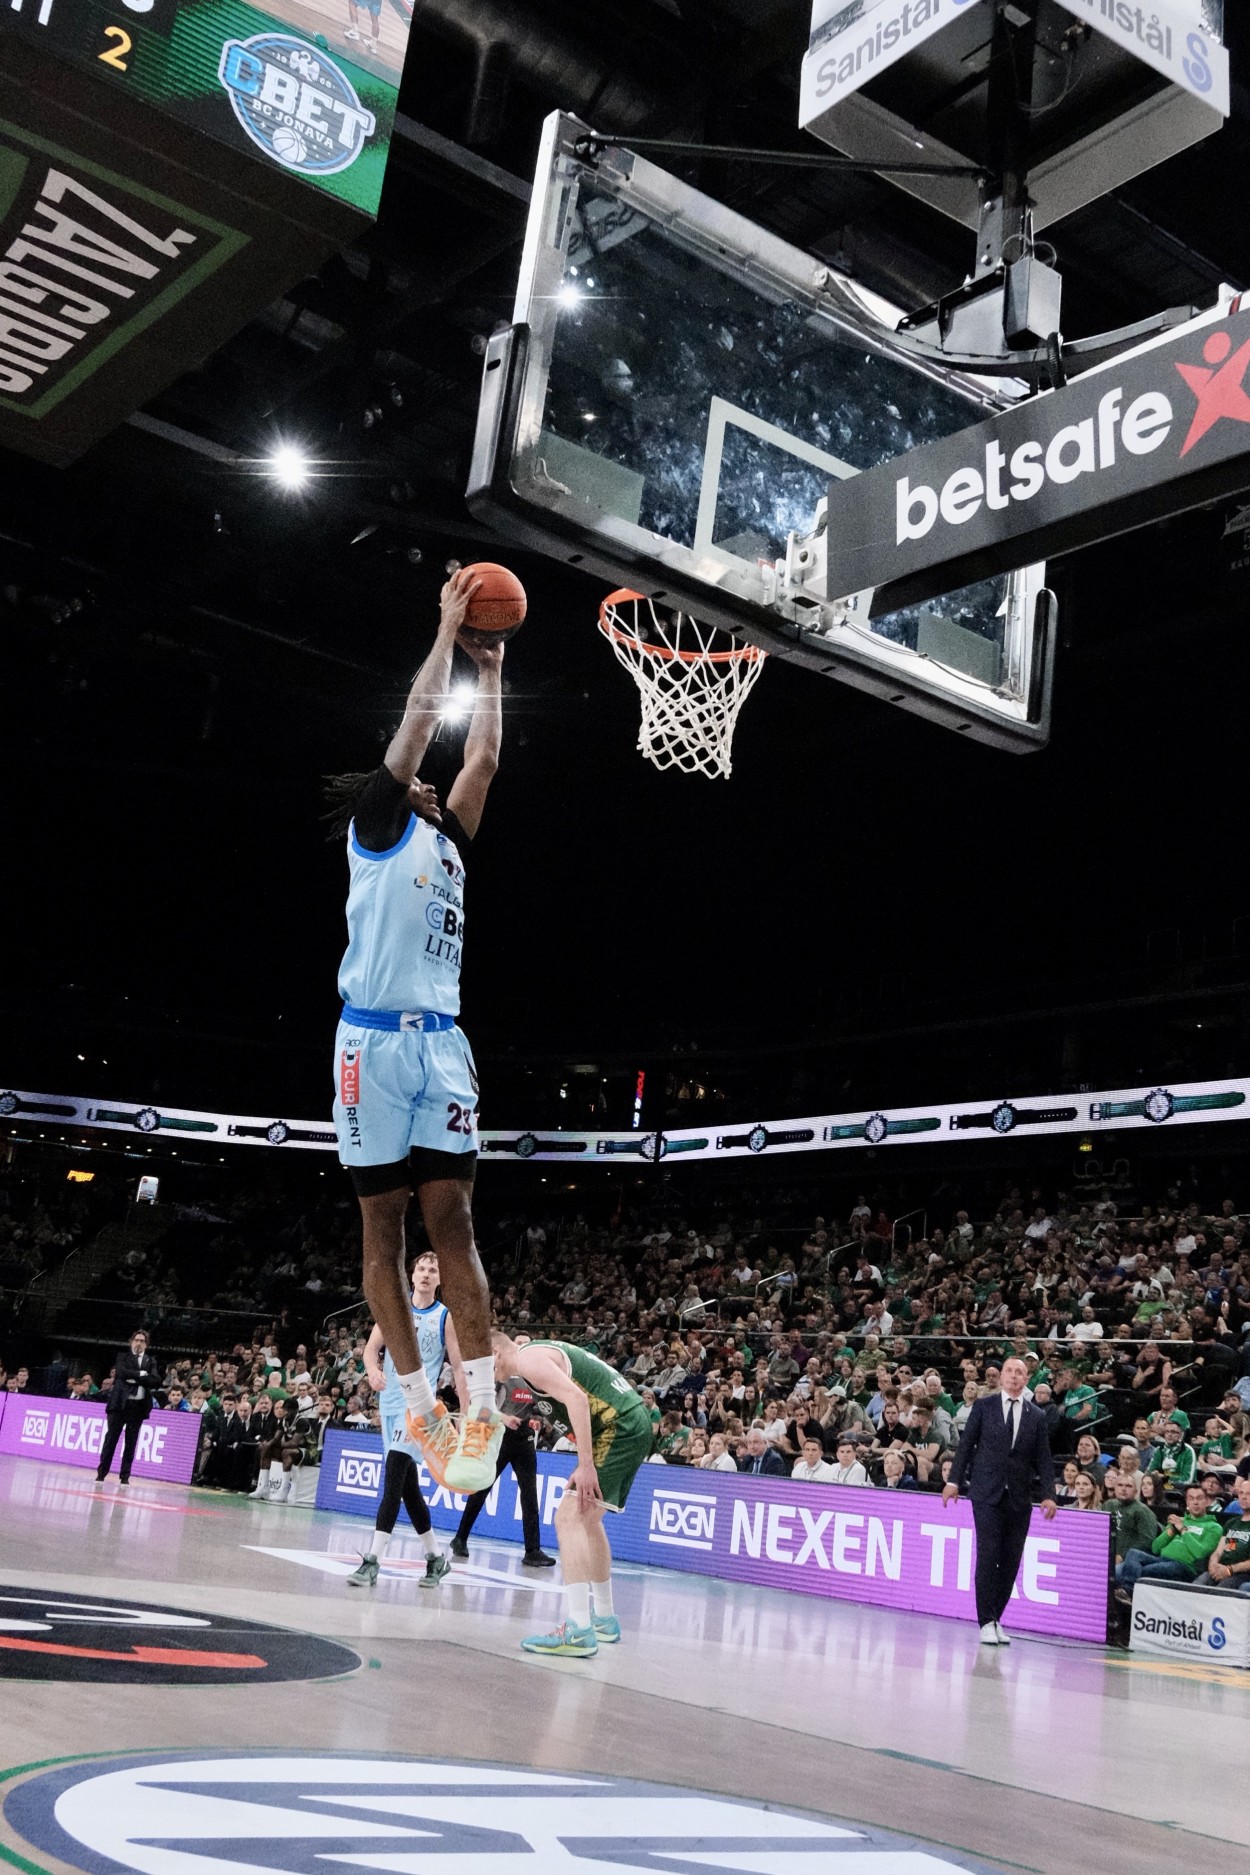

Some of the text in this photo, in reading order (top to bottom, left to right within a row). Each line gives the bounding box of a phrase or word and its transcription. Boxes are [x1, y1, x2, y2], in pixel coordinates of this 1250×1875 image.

[98, 25, 132, 72] 2
[225, 45, 370, 149] CBET
[252, 98, 334, 149] BC JONAVA
[896, 387, 1173, 546] betsafe
[430, 883, 464, 910] TALG
[50, 1413, 108, 1454] NEXE
[729, 1499, 904, 1580] NEXEN
[920, 1522, 1061, 1606] TIE
[1134, 1611, 1203, 1641] Sanistål
